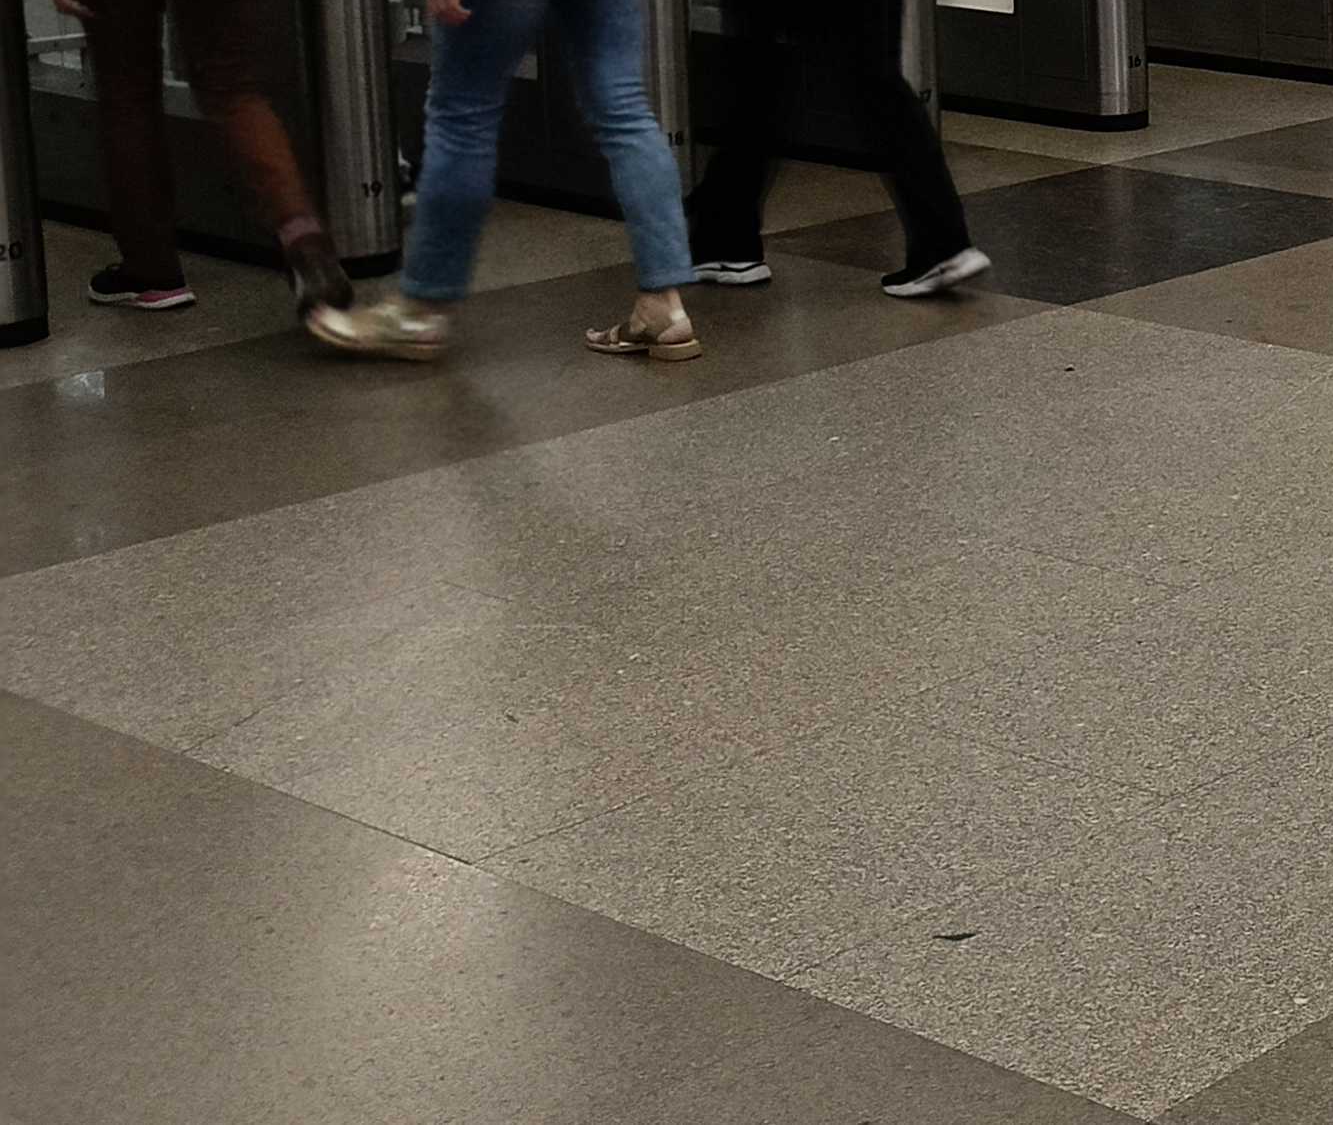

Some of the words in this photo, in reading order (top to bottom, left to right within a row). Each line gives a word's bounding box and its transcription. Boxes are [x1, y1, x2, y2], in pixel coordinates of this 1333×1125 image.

[1128, 55, 1142, 68] 16
[667, 130, 685, 147] 18
[361, 179, 383, 198] 19
